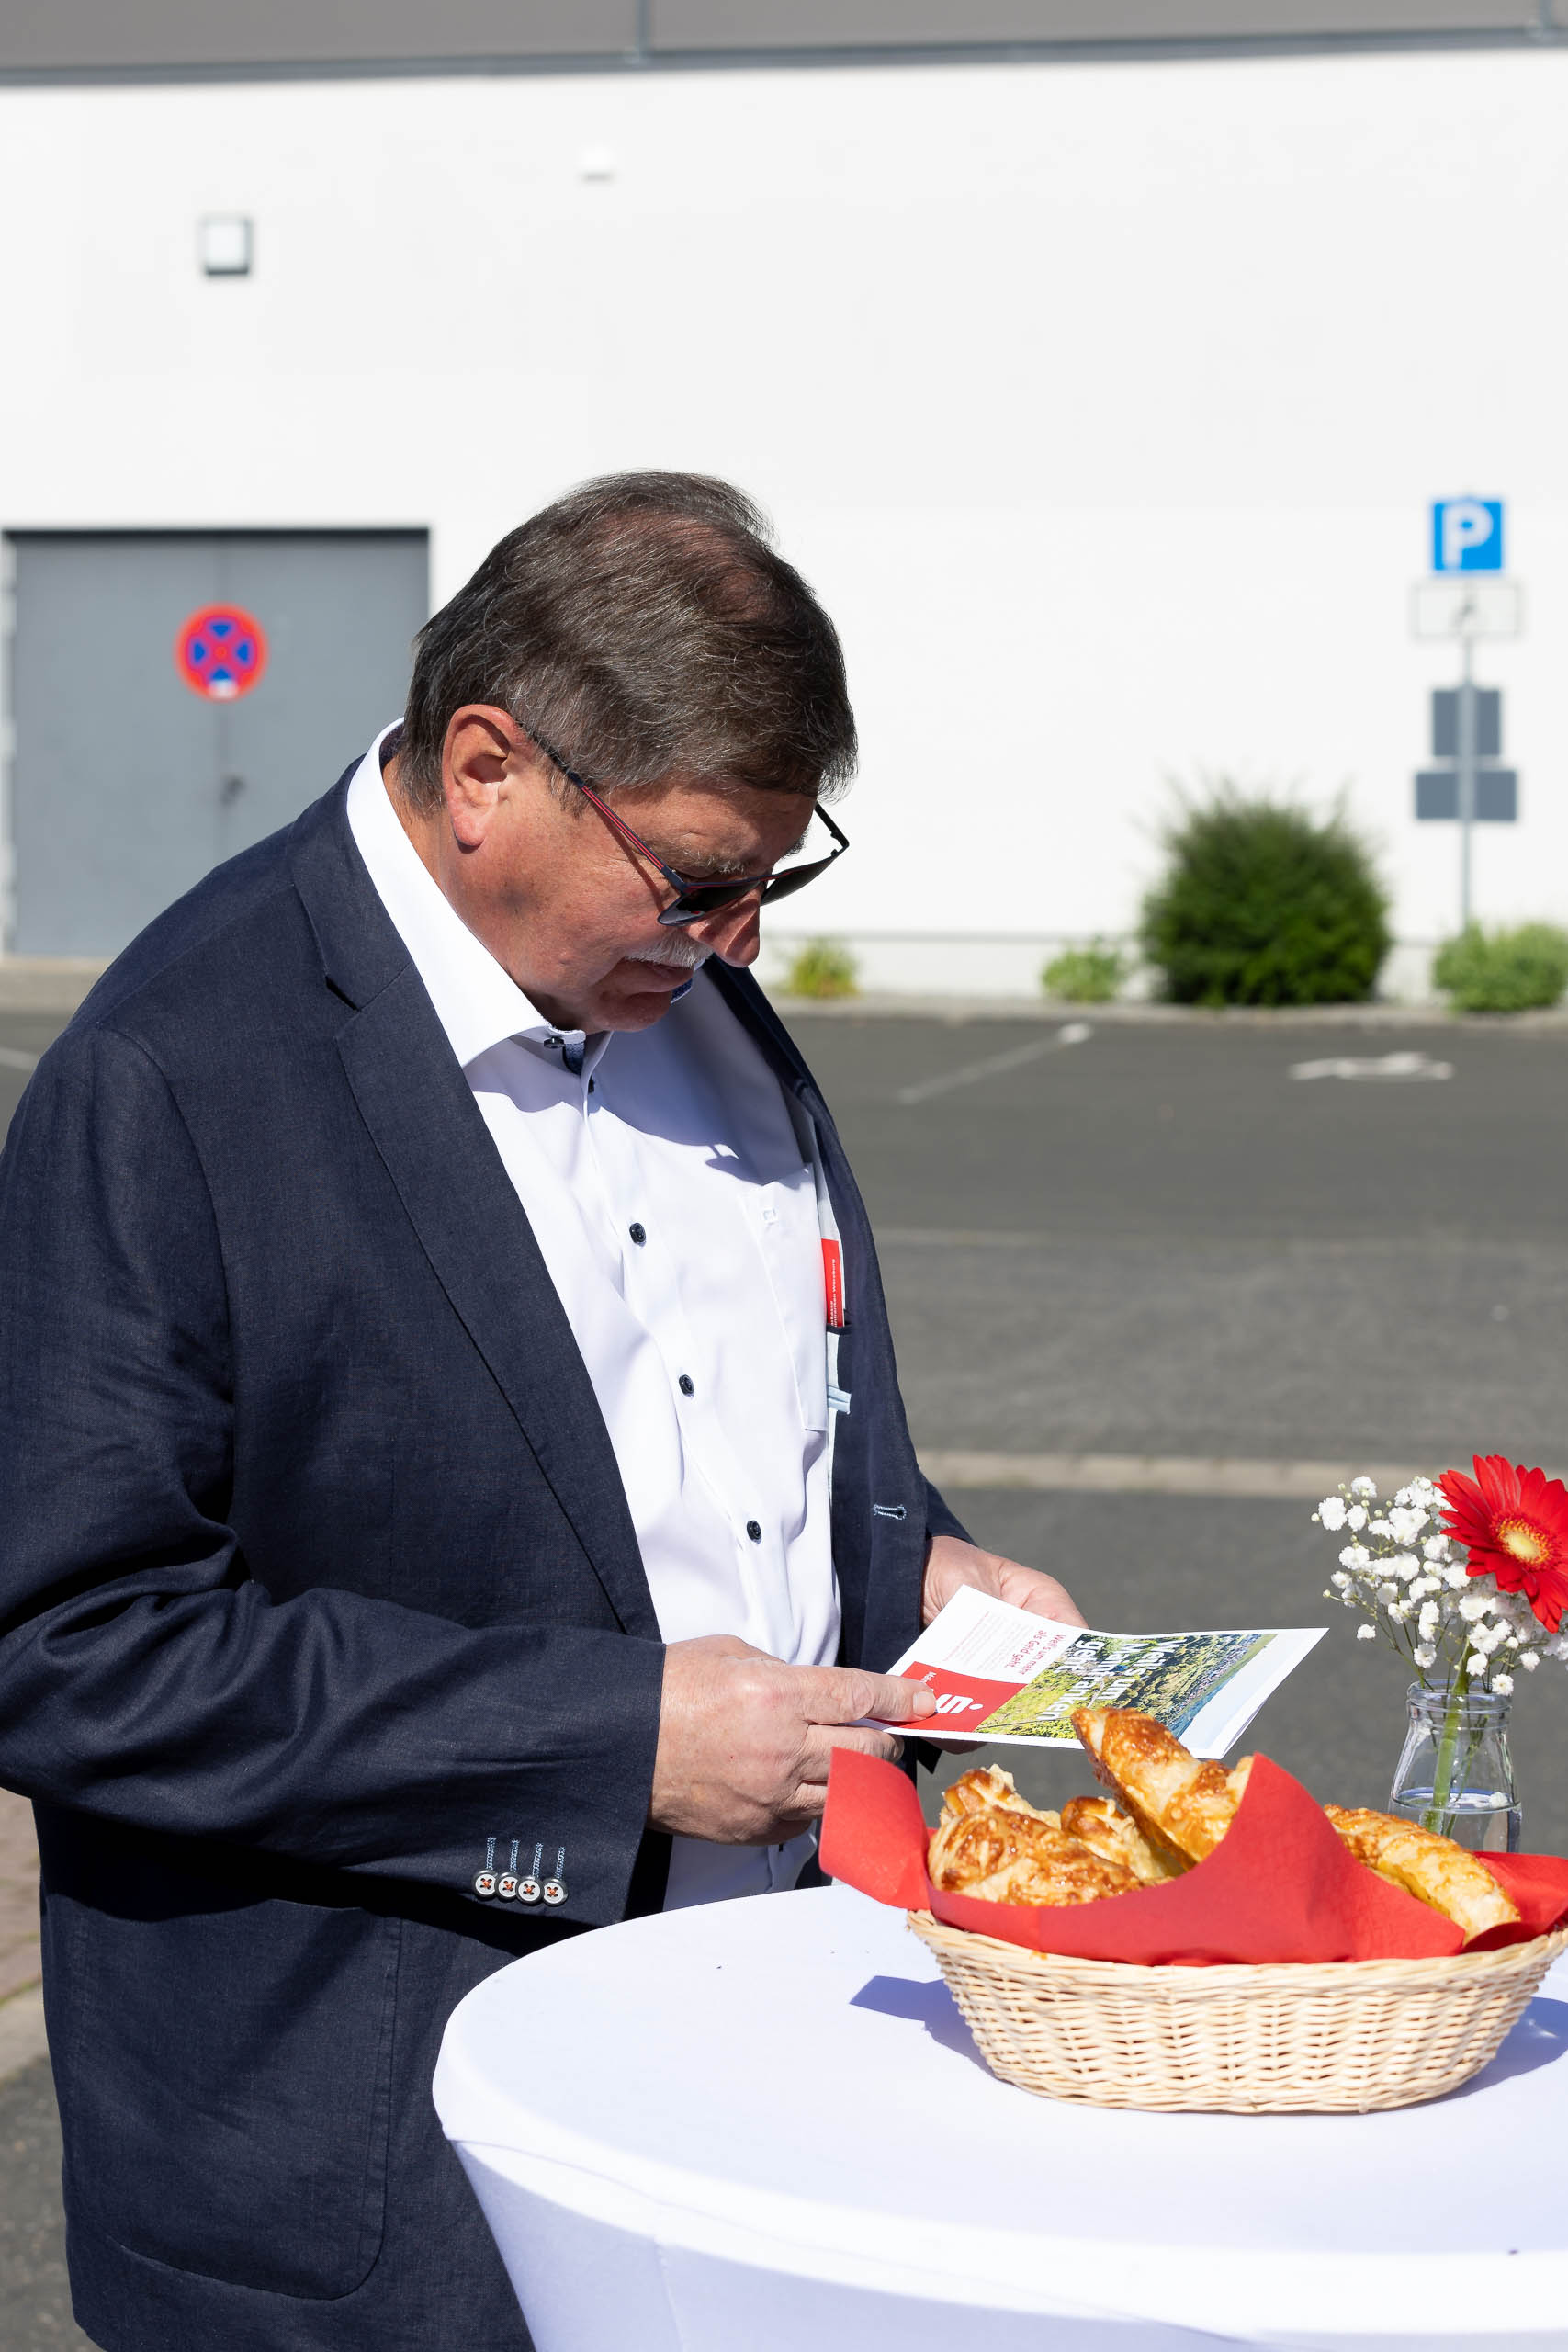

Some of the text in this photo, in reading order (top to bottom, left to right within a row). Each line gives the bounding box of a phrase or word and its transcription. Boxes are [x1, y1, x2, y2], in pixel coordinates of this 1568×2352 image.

[1441, 501, 1494, 571] P
[1033, 1630, 1048, 1639] als
[1020, 1640, 1040, 1655] Geld
[1032, 1650, 1048, 1660] um
[1018, 1660, 1037, 1675] mehr
[1098, 1638, 1188, 1700] Weil's um
[1034, 1643, 1149, 1721] Mainfranken
